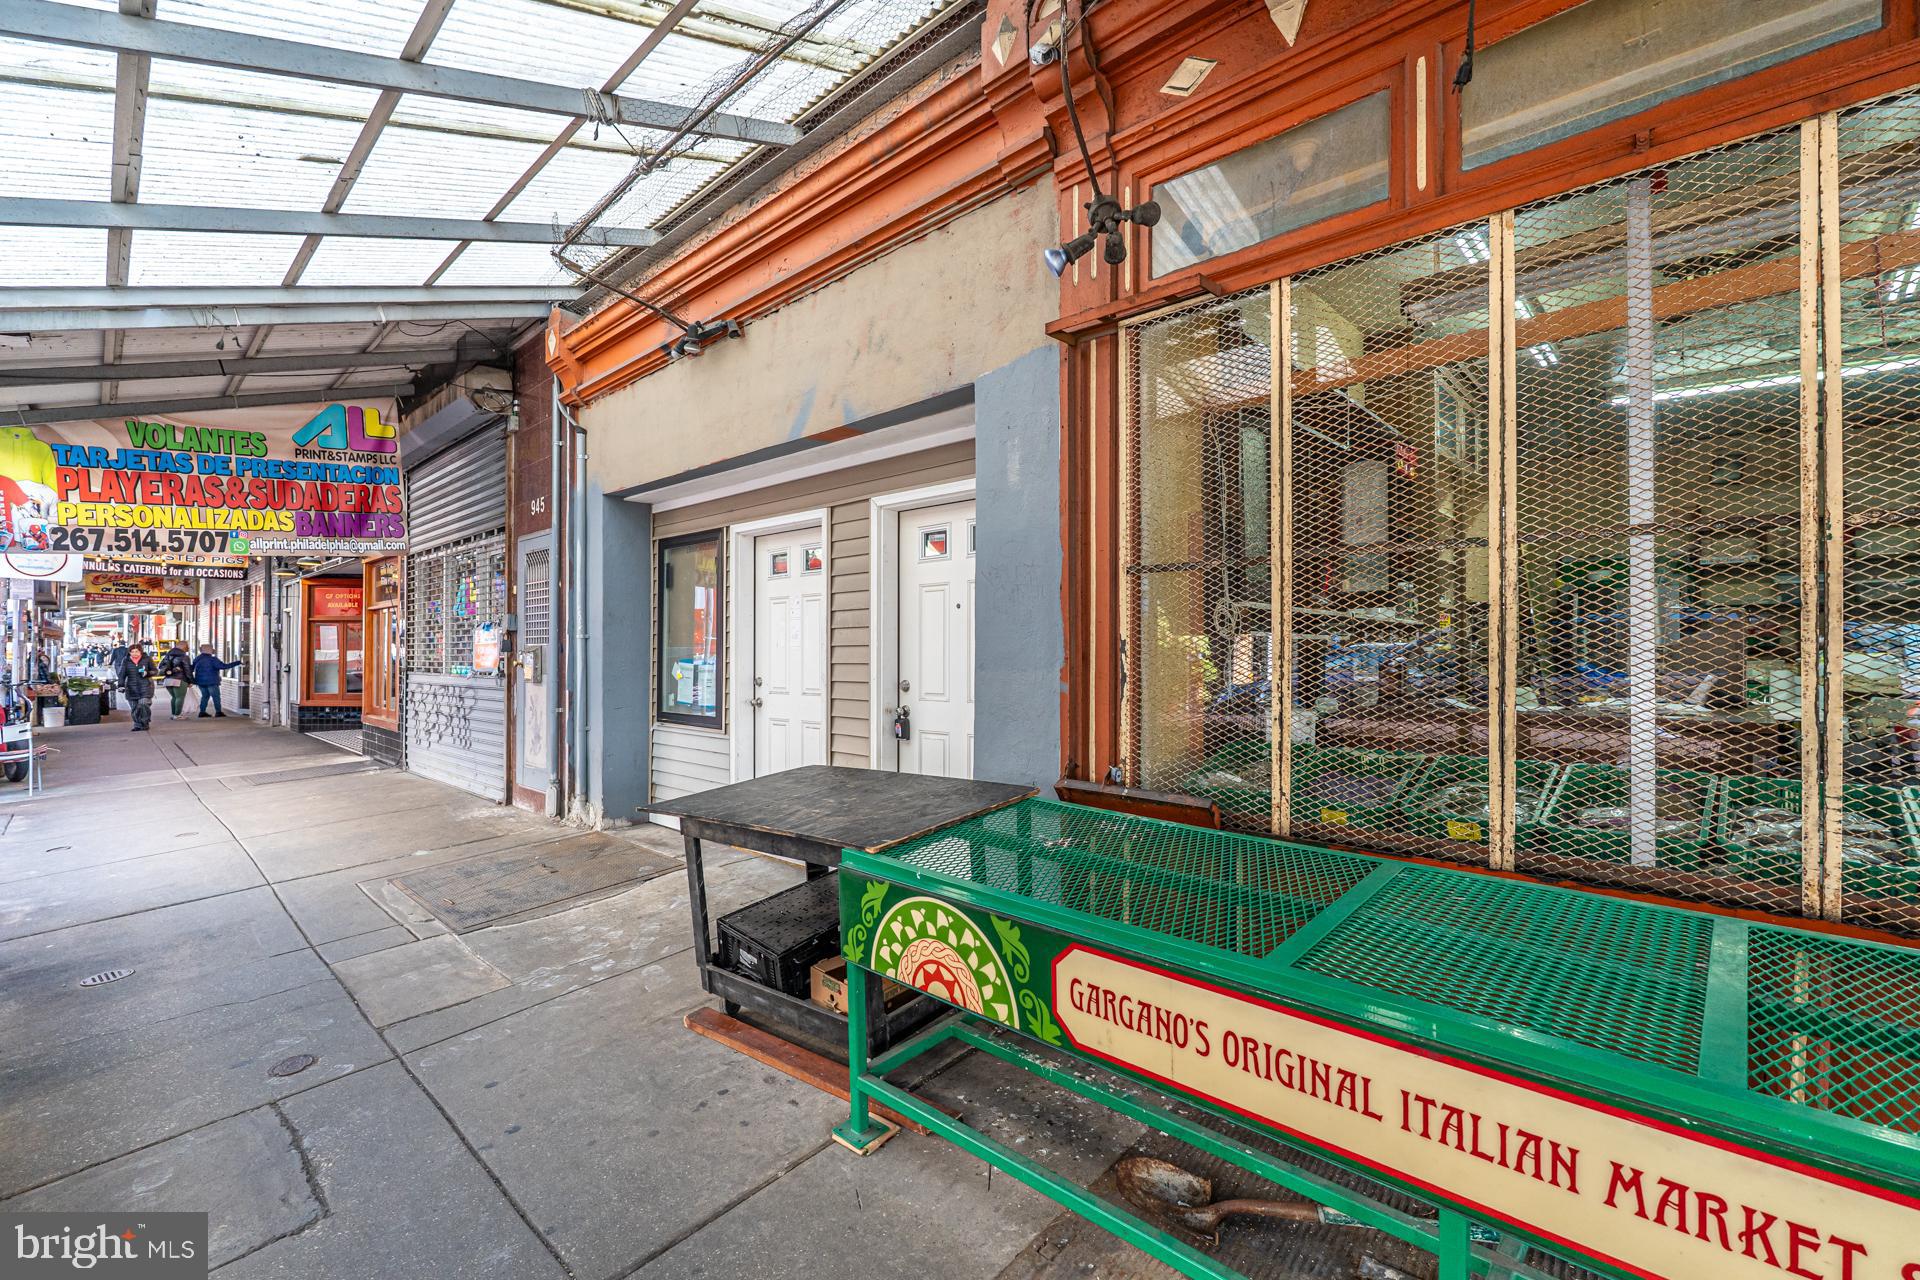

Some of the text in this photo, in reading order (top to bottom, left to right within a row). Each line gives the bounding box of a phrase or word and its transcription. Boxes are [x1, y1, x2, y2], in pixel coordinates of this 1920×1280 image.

[125, 421, 267, 457] VOLANTES
[51, 443, 400, 485] TARJETAS DE PRESENTACION
[295, 448, 397, 465] PRINT&STAMPS LLC
[56, 467, 403, 514] PLAYERAS&SUDADERAS
[530, 496, 546, 516] 945
[57, 502, 405, 540] PERSONALIZADAS BANNERS
[51, 526, 406, 554] 267.514.5707 allprint.philadelphia@gmail.com
[123, 564, 168, 575] CATERING
[169, 566, 183, 576] for
[184, 568, 194, 577] all
[196, 568, 244, 579] OCCASIONS
[211, 556, 245, 565] PIGS
[1070, 978, 1868, 1280] GARGANO'S ORIGINAL ITALIAN MARKET
